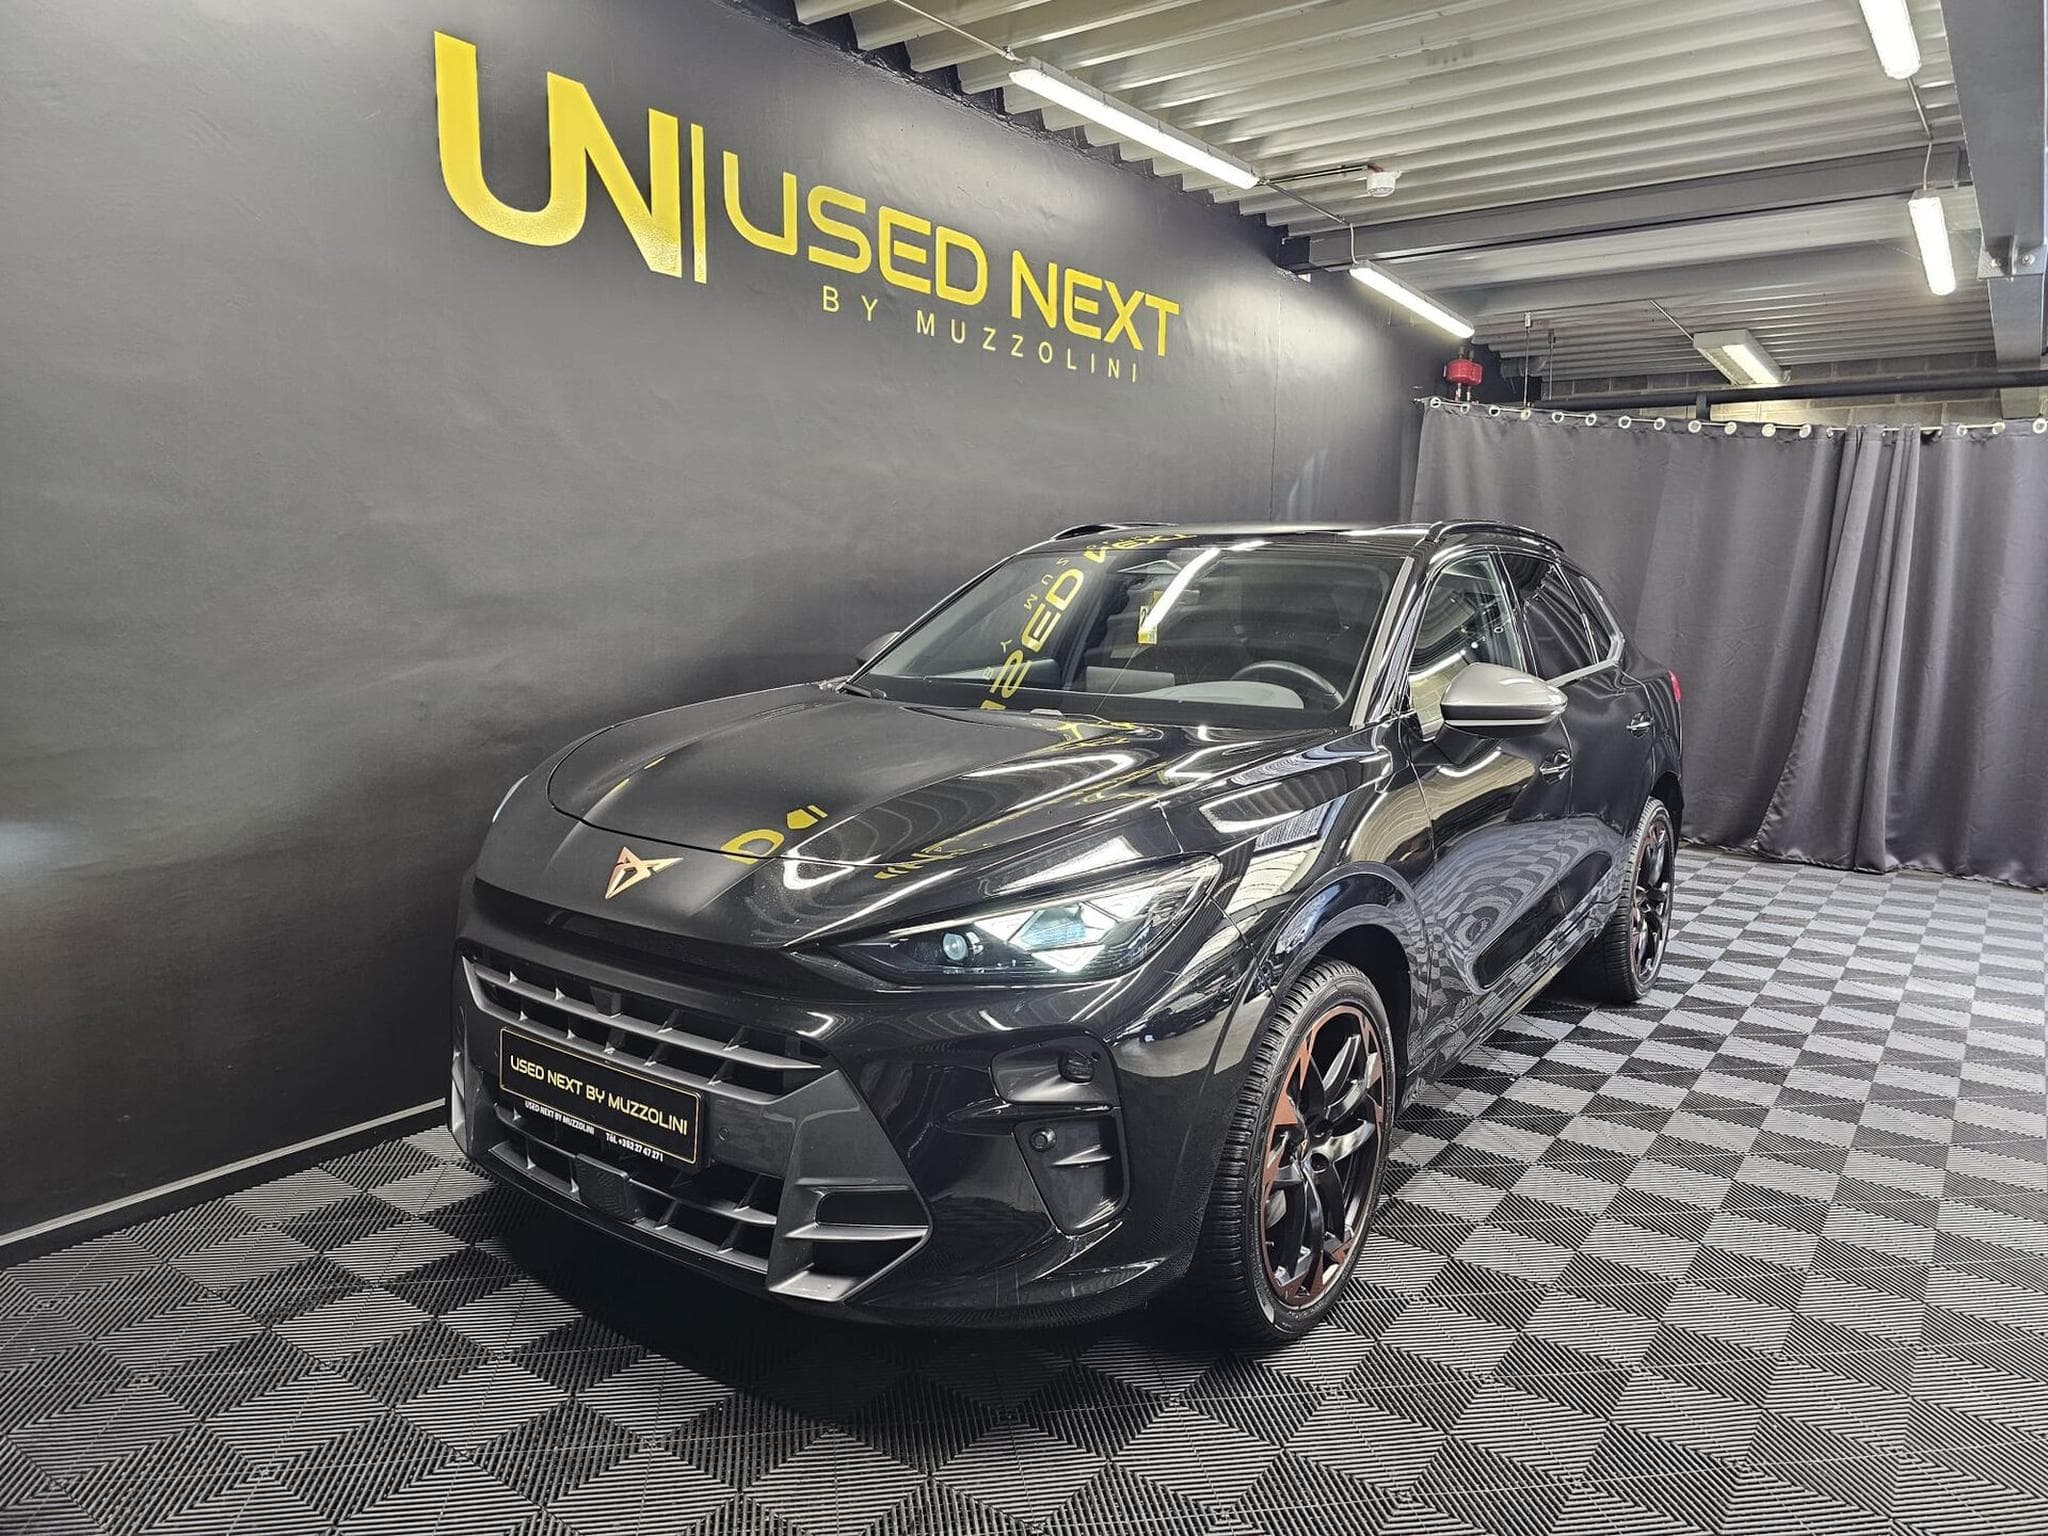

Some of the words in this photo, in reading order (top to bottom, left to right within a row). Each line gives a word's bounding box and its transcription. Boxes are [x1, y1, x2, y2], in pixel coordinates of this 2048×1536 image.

[722, 150, 989, 307] USED
[1010, 249, 1181, 358] NEXT
[821, 285, 880, 322] BY
[915, 309, 1141, 384] MUZZOLINI
[510, 1055, 545, 1081] USED
[547, 1071, 584, 1096] NEXT
[586, 1084, 606, 1104] BY
[608, 1093, 688, 1136] MUZZOLINI
[524, 1100, 540, 1113] USED
[540, 1106, 555, 1119] NEXT
[554, 1112, 563, 1122] BY
[562, 1115, 595, 1136] MUZZOLINI
